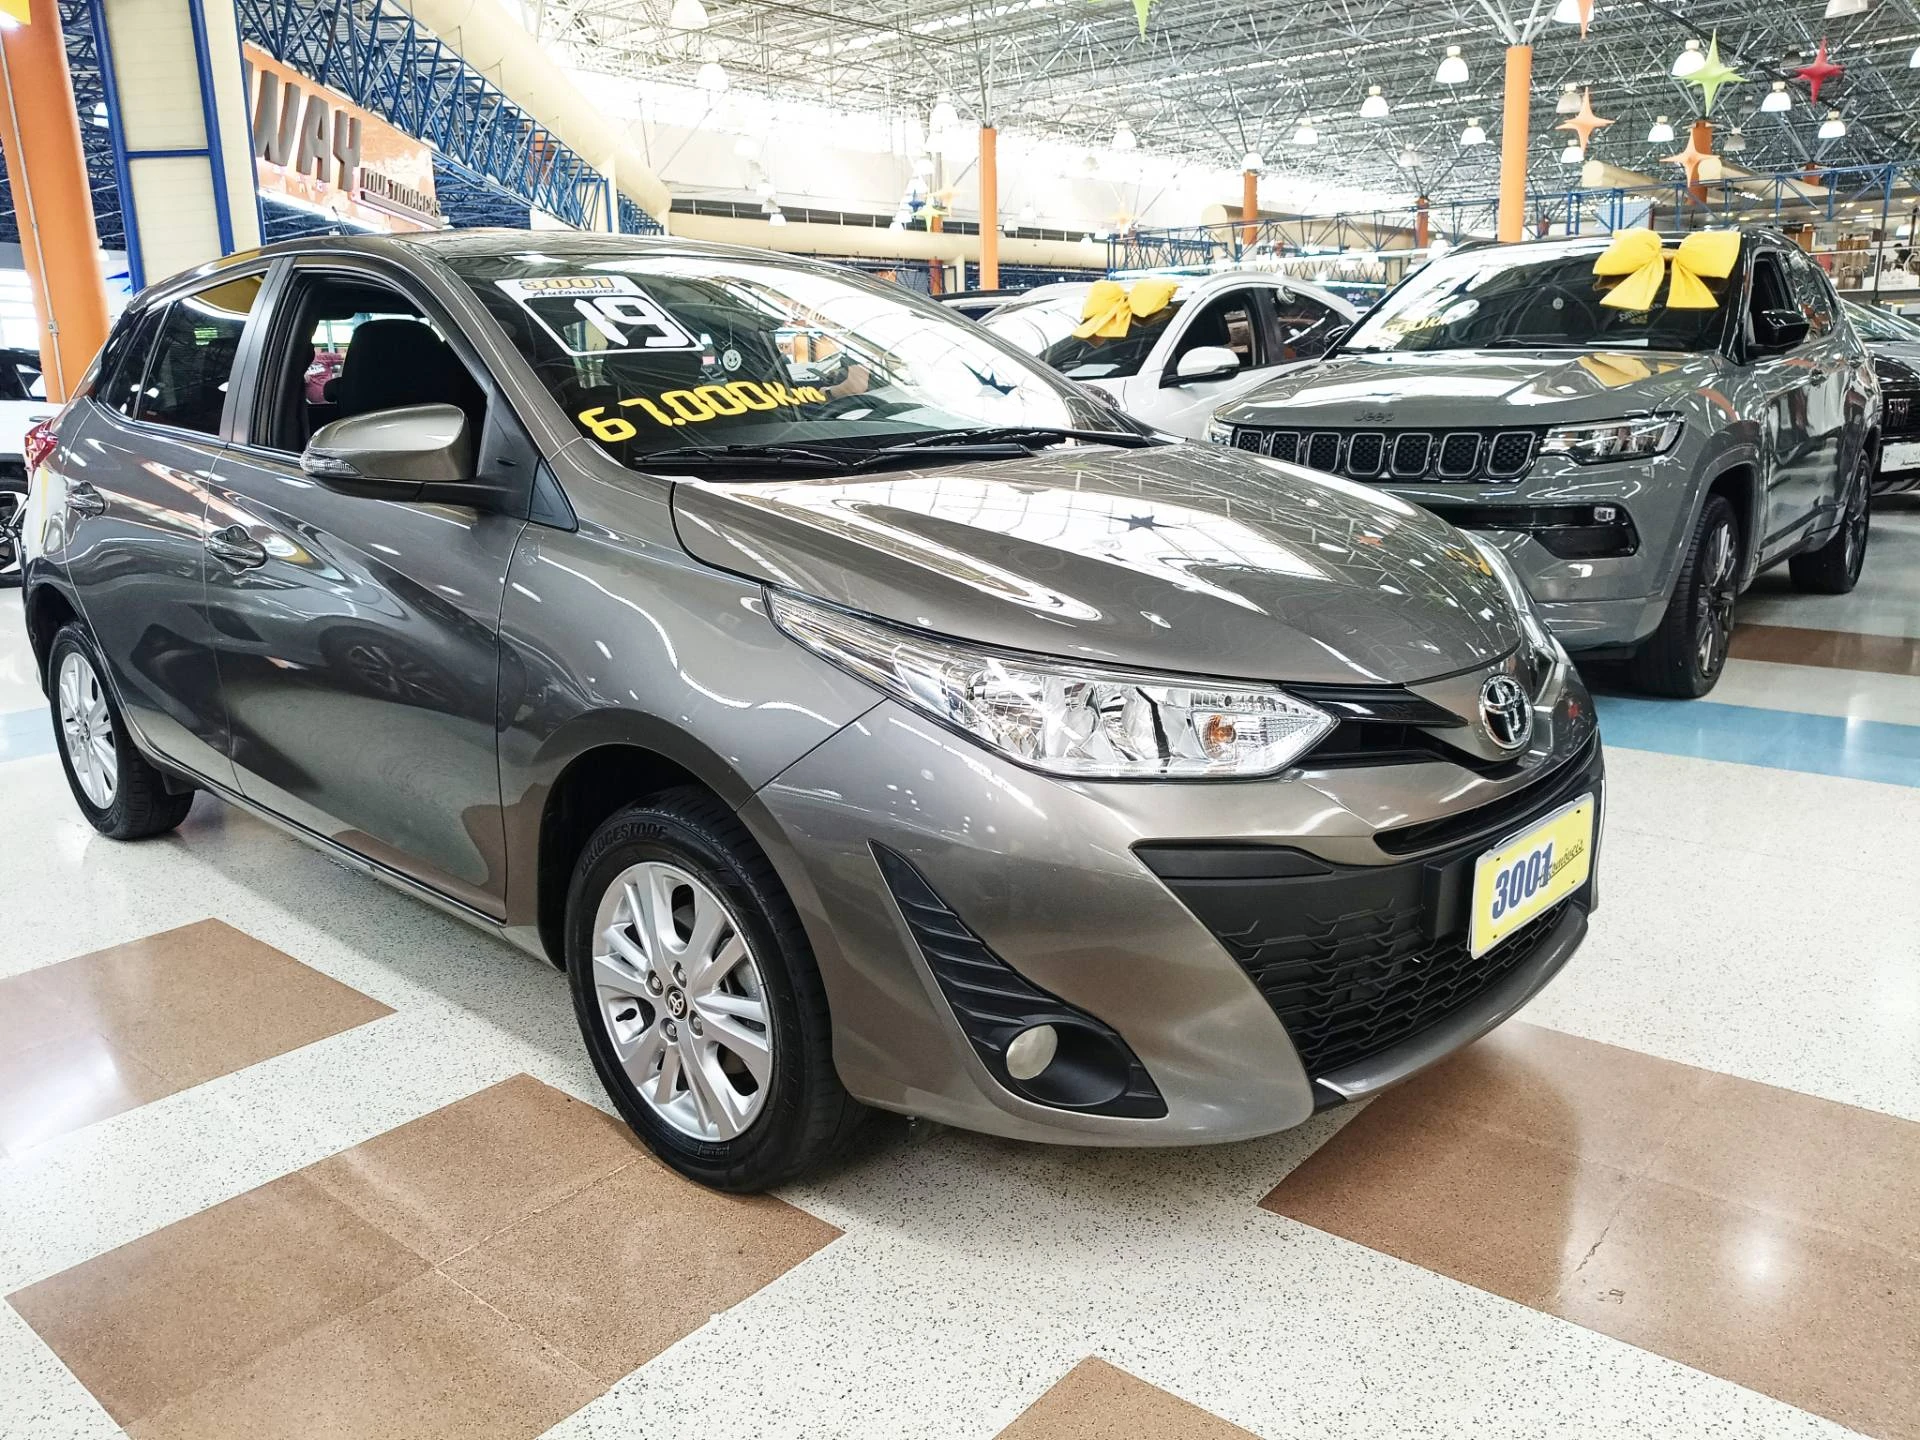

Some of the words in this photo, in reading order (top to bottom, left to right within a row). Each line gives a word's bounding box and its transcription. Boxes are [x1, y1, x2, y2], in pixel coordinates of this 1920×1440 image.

[519, 277, 615, 290] 3001
[573, 296, 691, 347] 19
[1354, 410, 1395, 424] Jeep
[1492, 842, 1553, 919] 3001
